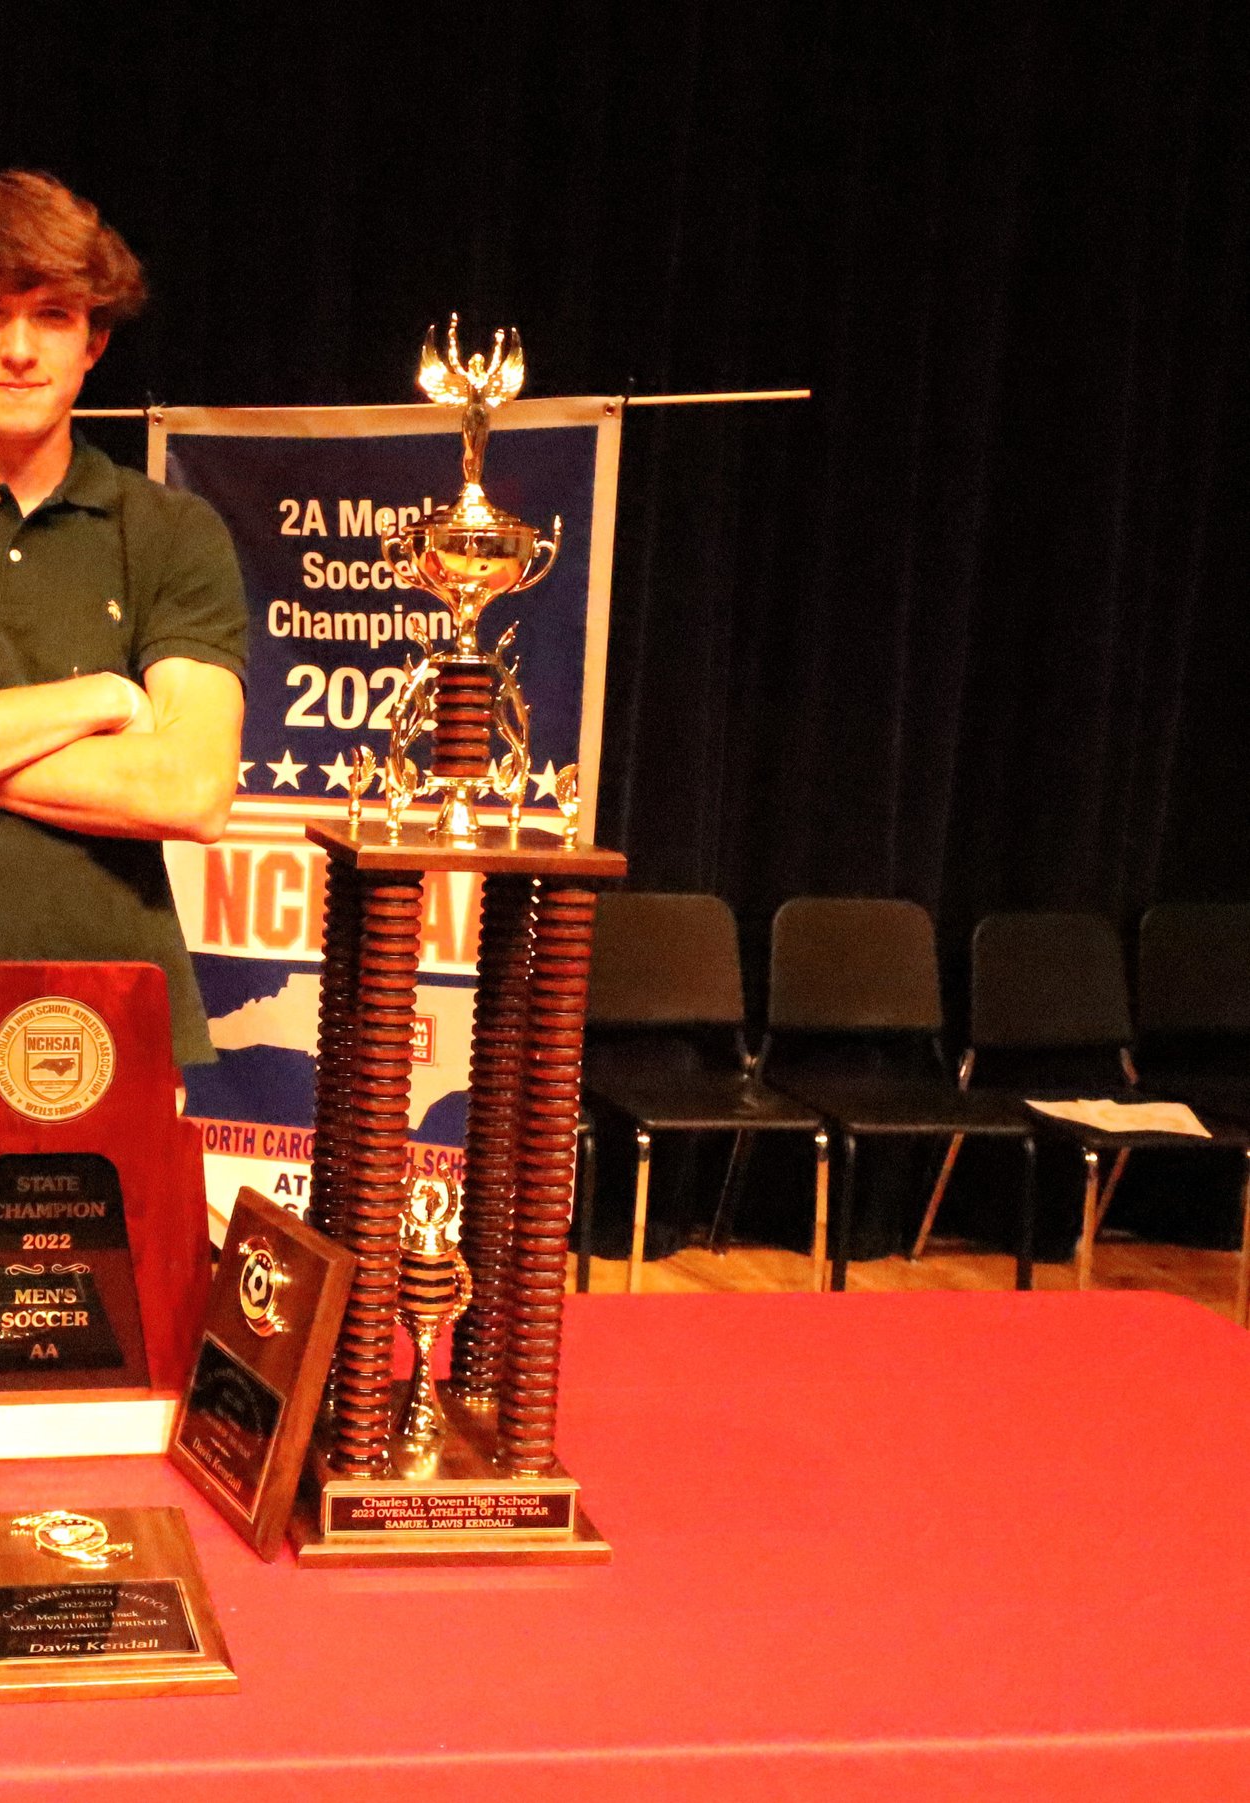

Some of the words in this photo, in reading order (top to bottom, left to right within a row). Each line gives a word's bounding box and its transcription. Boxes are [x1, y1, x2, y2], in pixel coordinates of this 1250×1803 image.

[279, 499, 327, 537] 2A
[339, 497, 449, 537] Men'
[14, 1008, 36, 1028] HIGH
[35, 1004, 72, 1016] SCHOOL
[72, 1009, 105, 1040] ATHLETIC
[89, 1040, 111, 1097] ASSOCIATION
[27, 1036, 81, 1051] NCHSAA
[24, 1101, 54, 1116] WELLS
[16, 1175, 81, 1193] STATE
[22, 1233, 72, 1250] 2022
[14, 1288, 78, 1305] MEN'S
[0, 1310, 89, 1329] SOCCER
[29, 1343, 60, 1360] AA
[192, 1436, 213, 1463] Davis
[212, 1456, 242, 1493] Kendall
[362, 1496, 409, 1508] Charles
[411, 1497, 425, 1507] D.
[427, 1496, 465, 1507] Owen
[467, 1495, 496, 1509] High
[498, 1495, 540, 1507] School
[351, 1508, 375, 1518] 2023
[376, 1507, 426, 1518] OVERALL
[428, 1507, 478, 1517] ATHLETE
[478, 1507, 494, 1517] OF
[495, 1506, 518, 1516] THE
[520, 1506, 549, 1516] YEAR
[385, 1519, 430, 1529] SAMUEL
[431, 1519, 463, 1529] DAVIS
[465, 1518, 514, 1528] KENDALL
[27, 1588, 72, 1605] OWEN
[75, 1587, 113, 1597] HIGH
[116, 1590, 170, 1614] SCHOOL
[57, 1600, 114, 1610] 2022-2023
[35, 1612, 69, 1622] Men's
[71, 1611, 107, 1620] Indoor
[110, 1609, 139, 1619] Track
[10, 1623, 43, 1632] MOST
[47, 1620, 111, 1631] VALUABLE
[110, 1618, 169, 1628] SPRINTER
[29, 1641, 81, 1654] Davis
[86, 1638, 160, 1651] Kendall
